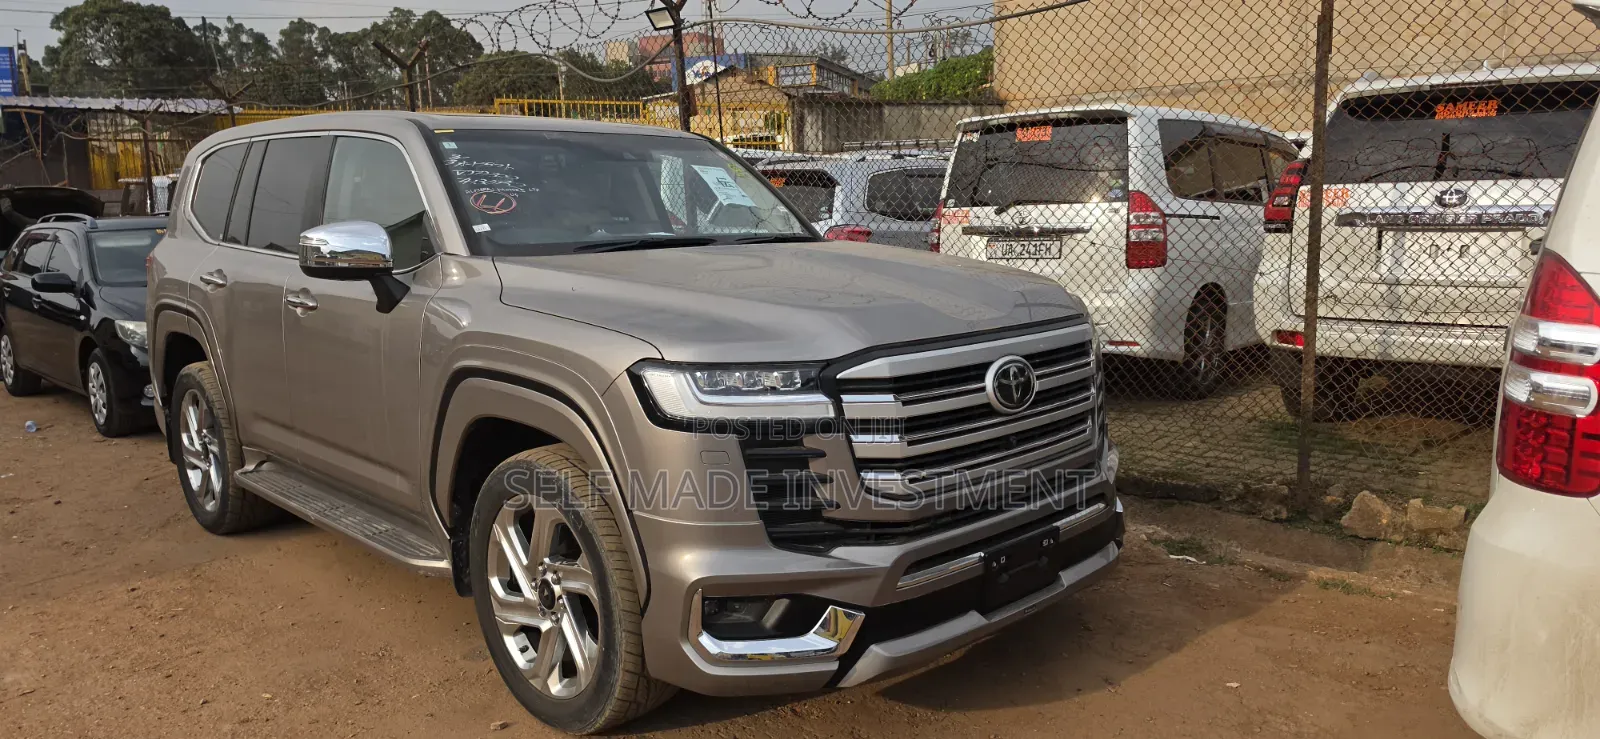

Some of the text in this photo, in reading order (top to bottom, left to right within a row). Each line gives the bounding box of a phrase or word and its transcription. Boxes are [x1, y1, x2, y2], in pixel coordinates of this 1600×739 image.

[1435, 99, 1498, 112] SAMEER
[1365, 214, 1539, 225] LAND CRUISER PRADO
